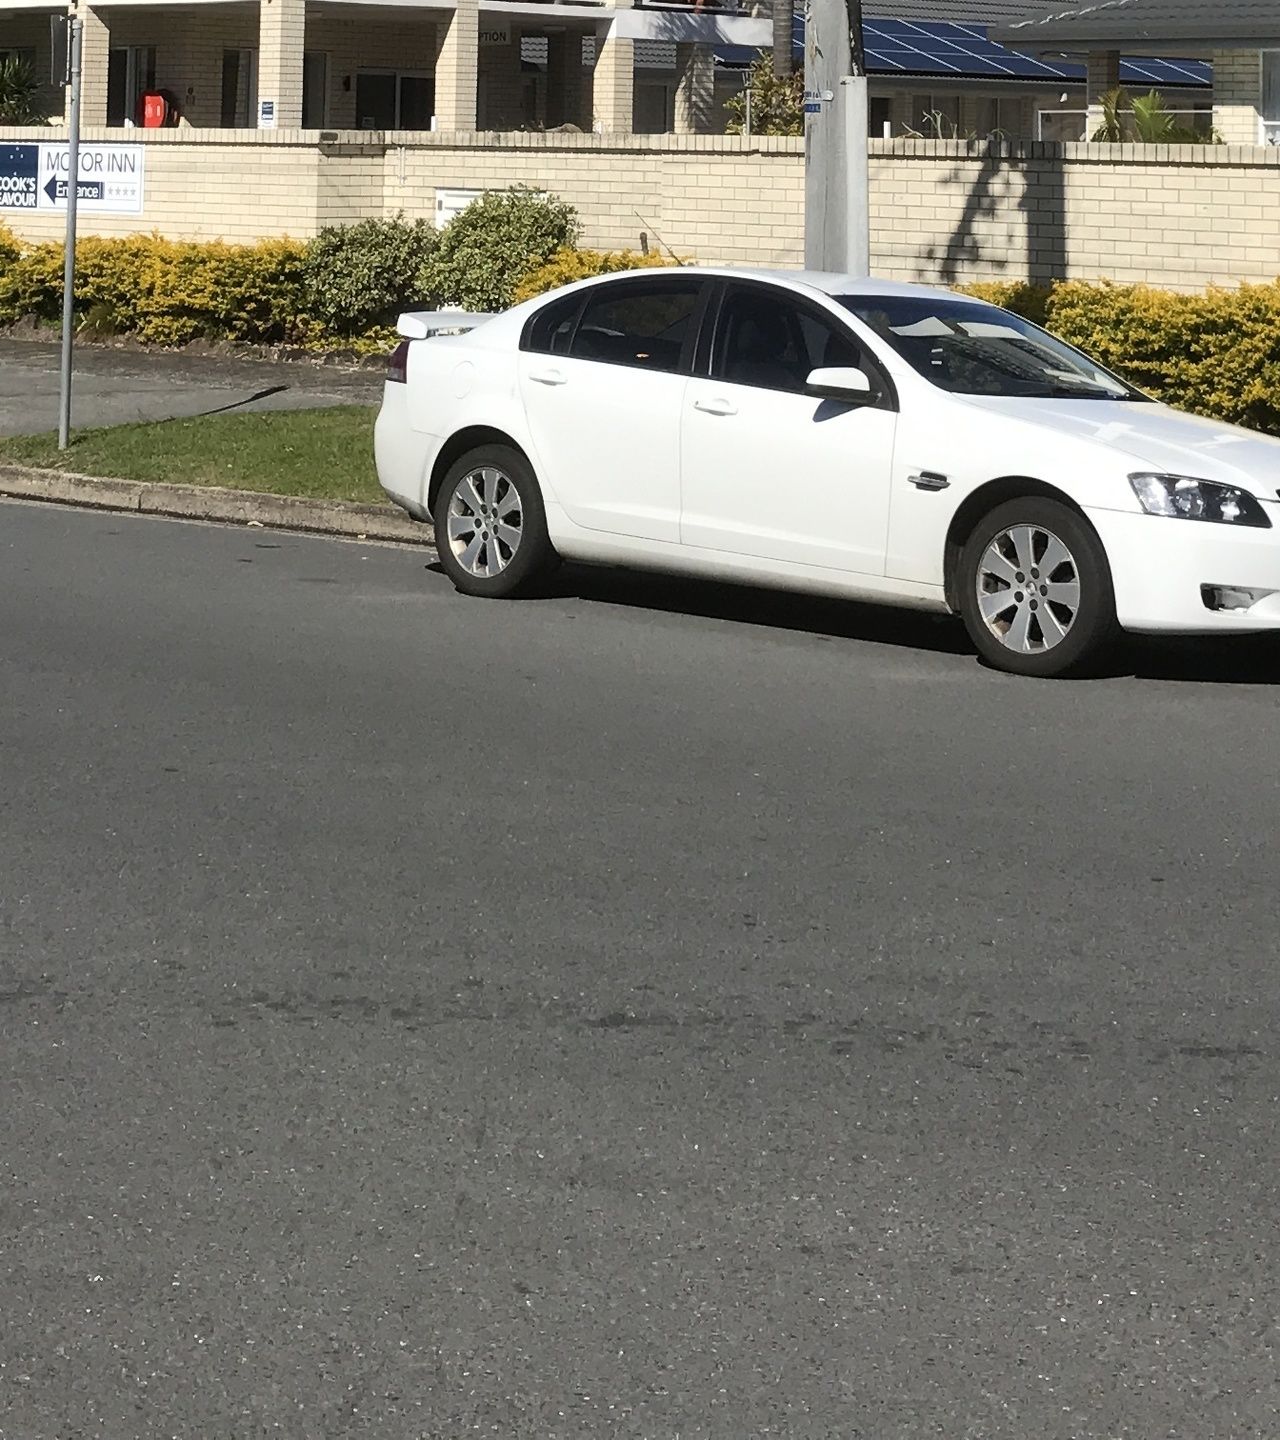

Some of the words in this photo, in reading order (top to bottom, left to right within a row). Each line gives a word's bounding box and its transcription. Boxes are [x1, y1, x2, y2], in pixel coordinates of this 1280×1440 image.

[46, 151, 103, 172] MOOR
[107, 153, 135, 173] INN
[56, 181, 99, 198] Enance
